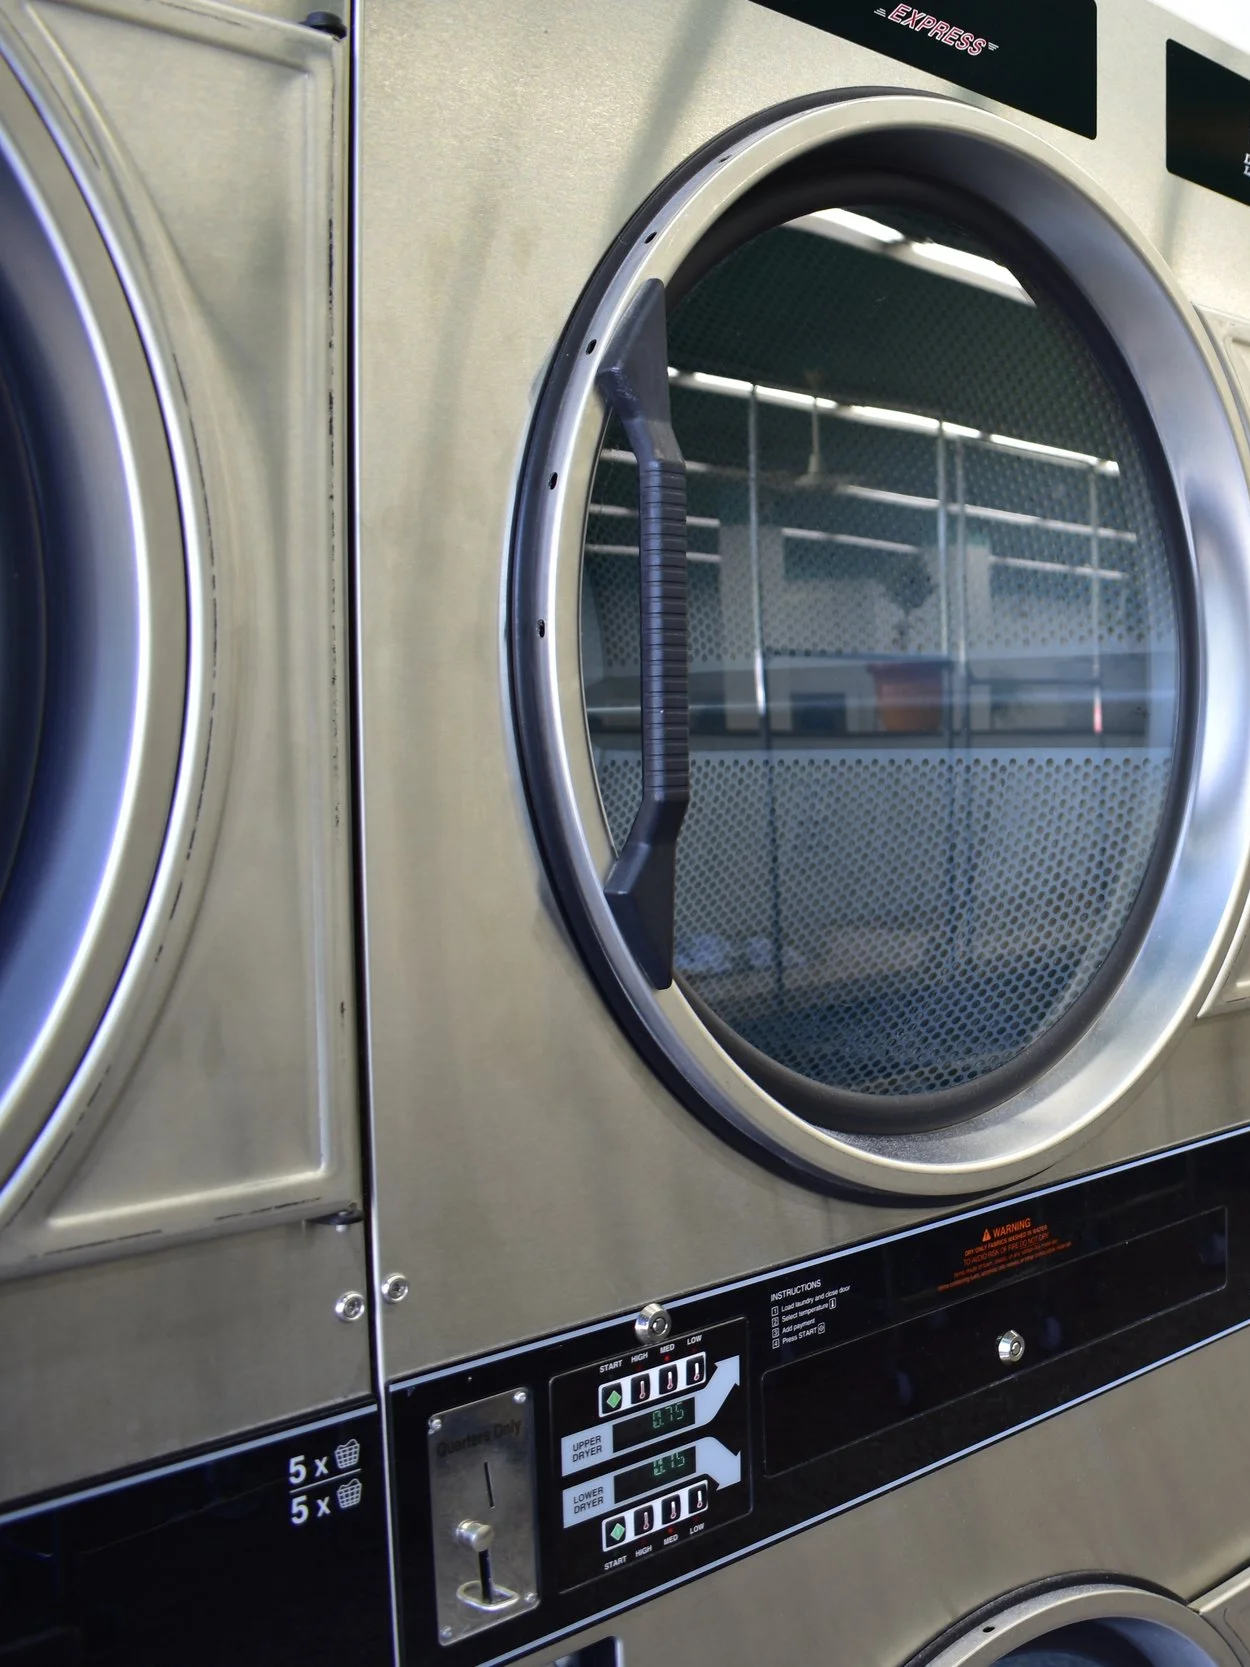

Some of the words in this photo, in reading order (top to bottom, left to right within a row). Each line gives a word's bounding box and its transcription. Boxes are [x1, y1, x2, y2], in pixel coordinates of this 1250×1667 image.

[888, 3, 986, 56] EXPRESS
[993, 1218, 1032, 1237] WARNING
[770, 1279, 822, 1302] INSTRUCTIONS
[782, 1302, 794, 1312] Load
[795, 1297, 814, 1308] laundry
[815, 1292, 825, 1302] and
[825, 1289, 838, 1298] close
[839, 1285, 850, 1294] door
[782, 1312, 798, 1322] Select
[798, 1302, 828, 1317] temperature
[782, 1326, 792, 1334] Add
[794, 1318, 816, 1332] payment
[782, 1334, 798, 1344] Press
[798, 1327, 818, 1339] START
[600, 1359, 623, 1373] START
[630, 1352, 648, 1364] HIGH
[660, 1343, 675, 1354] MED
[686, 1334, 702, 1346] LOW
[438, 1430, 490, 1457] Quarters
[572, 1435, 602, 1452] UPPER
[572, 1446, 602, 1462] DRYER
[289, 1454, 306, 1484] 5
[314, 1456, 328, 1478] x
[574, 1486, 604, 1504] LOWER
[574, 1496, 604, 1514] DRYER
[291, 1495, 309, 1524] 5
[316, 1496, 330, 1518] x
[604, 1556, 628, 1571] START
[636, 1545, 652, 1558] HIGH
[664, 1534, 678, 1546] MED
[690, 1522, 704, 1535] LOW
